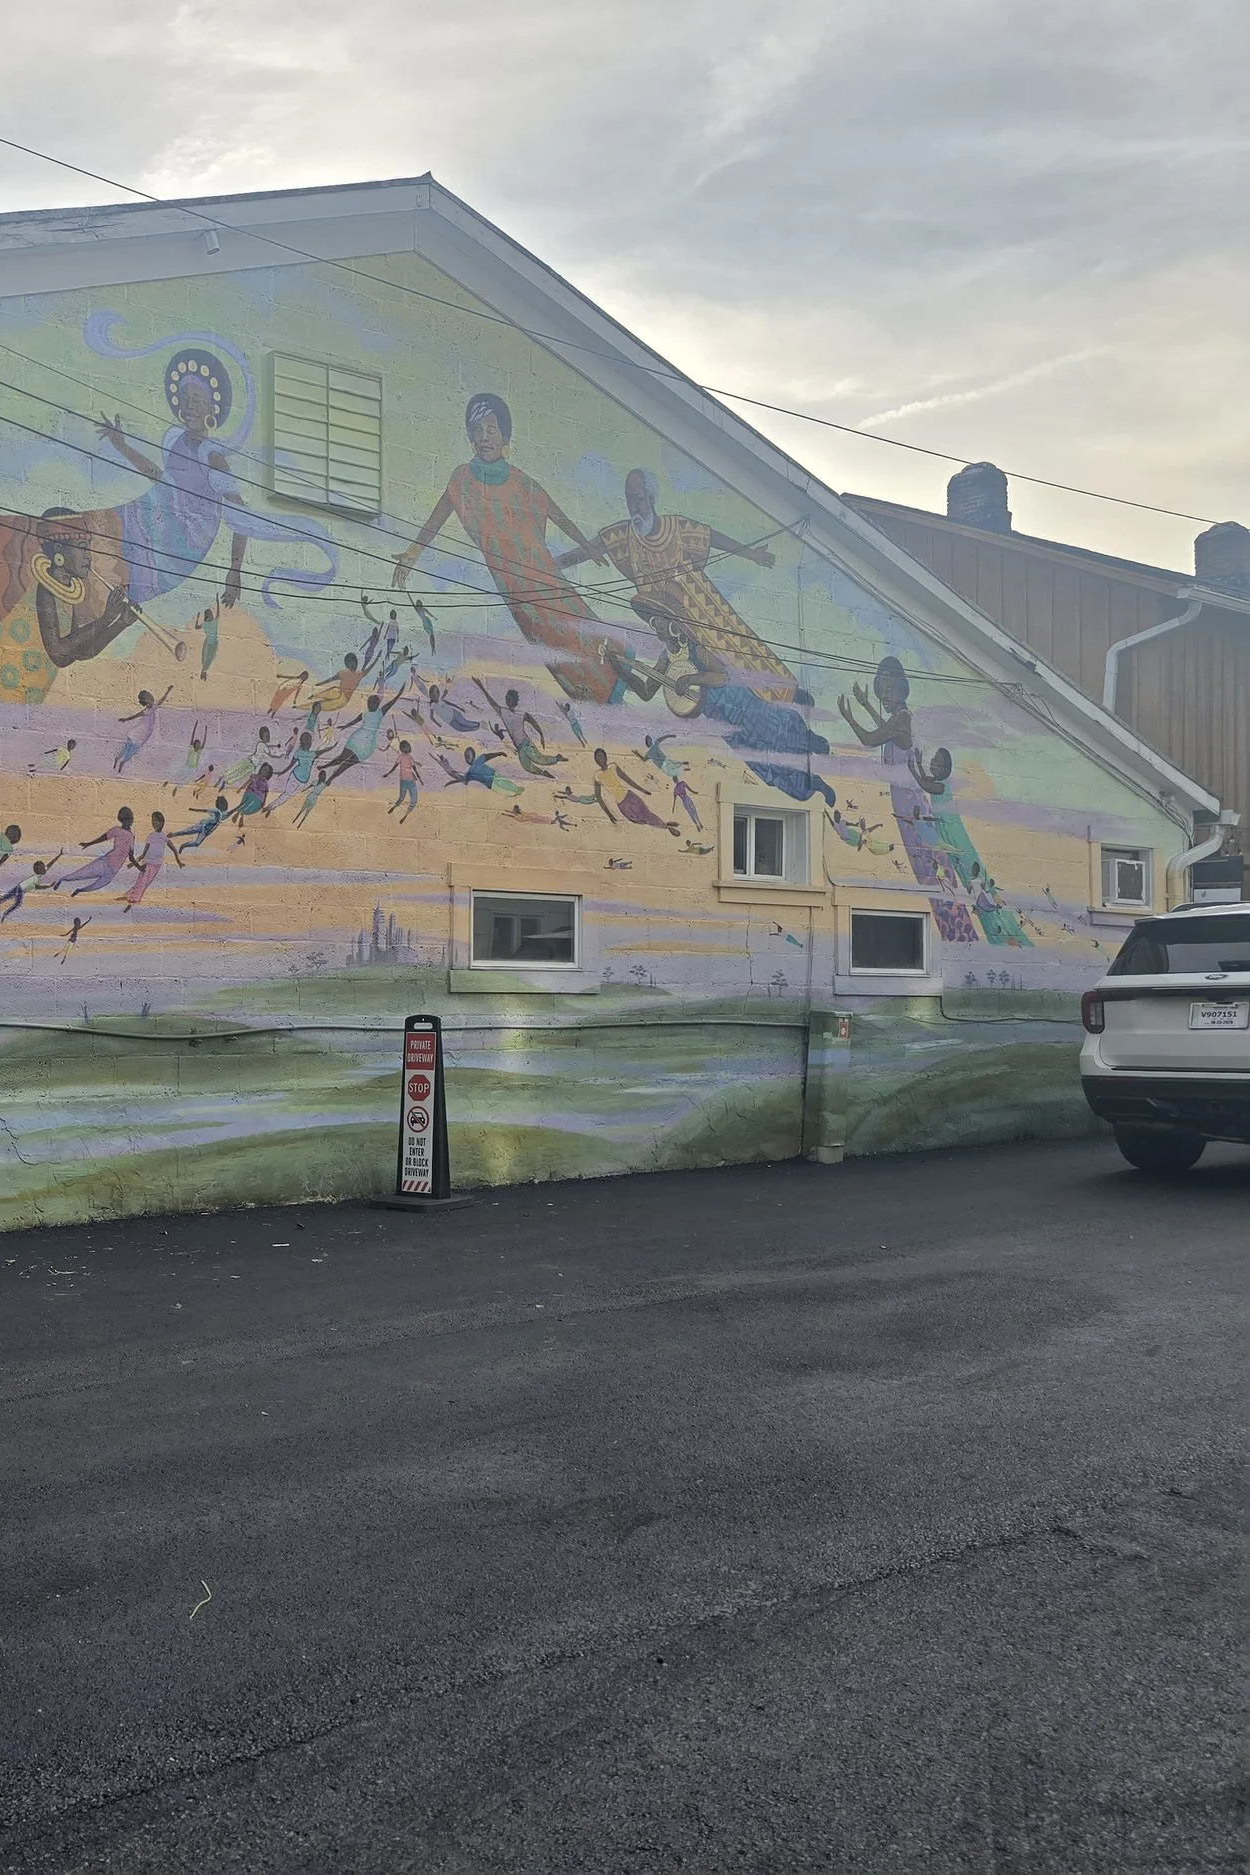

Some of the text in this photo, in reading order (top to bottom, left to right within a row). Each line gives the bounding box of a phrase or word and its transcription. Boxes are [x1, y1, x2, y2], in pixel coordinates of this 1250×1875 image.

[410, 1040, 431, 1050] PRIVATE
[407, 1053, 434, 1063] DRIVEWAY
[408, 1083, 430, 1093] STOP
[408, 1137, 426, 1147] DO NOT
[409, 1147, 425, 1156] ENTER
[405, 1157, 429, 1167] OR BLOCK
[404, 1167, 430, 1177] DRIVEWAY
